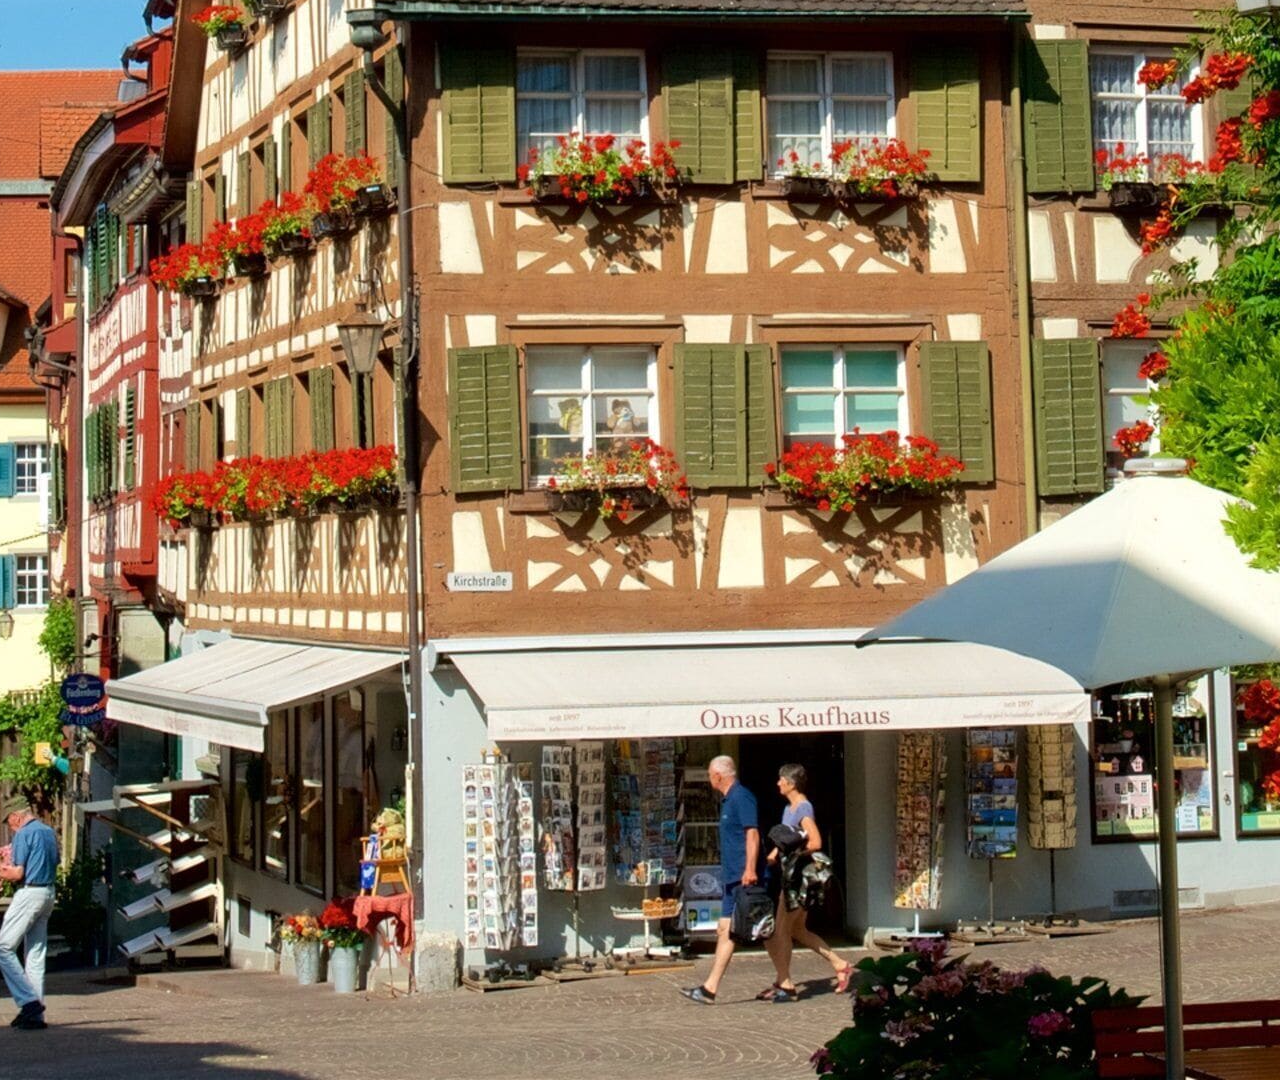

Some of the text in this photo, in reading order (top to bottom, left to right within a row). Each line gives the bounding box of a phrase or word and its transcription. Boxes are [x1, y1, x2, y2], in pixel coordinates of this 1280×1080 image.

[453, 575, 507, 587] Kirchstraße
[700, 706, 891, 730] Omas Kaufhaus
